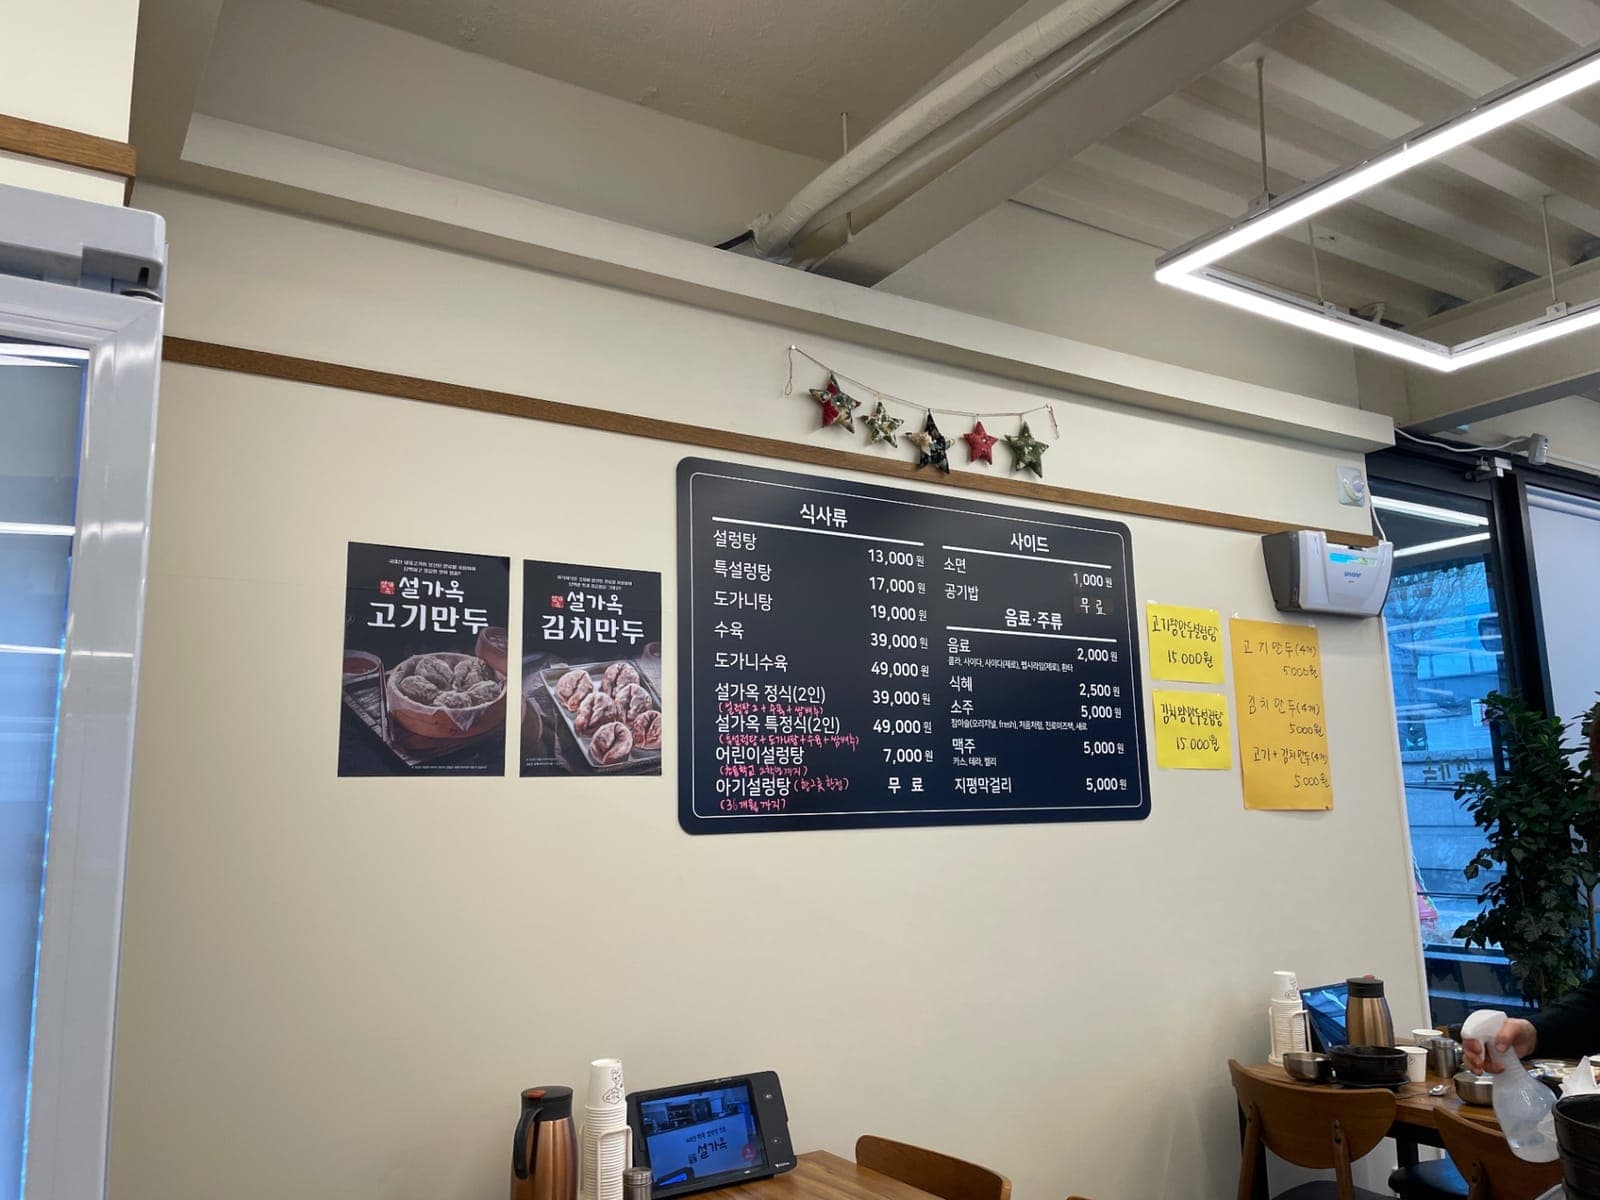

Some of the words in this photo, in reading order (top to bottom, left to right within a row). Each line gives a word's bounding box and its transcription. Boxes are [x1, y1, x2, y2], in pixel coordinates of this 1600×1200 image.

[799, 503, 848, 528] 식사류
[713, 529, 757, 551] 설렁탕
[1010, 532, 1050, 552] 사이드
[713, 559, 772, 582] 특설렁탕
[943, 557, 967, 574] 소면
[399, 577, 464, 603] 설가옥
[944, 583, 980, 602] 공기밥
[567, 591, 623, 615] 설가옥
[713, 591, 773, 611] 도가니탕
[367, 602, 489, 635] 고기만두
[1004, 608, 1063, 631] 음료·주류
[541, 615, 645, 645] 김치만두
[714, 621, 744, 640] 수육
[947, 637, 971, 654] 음료
[714, 652, 788, 673] 도가니수육
[715, 683, 760, 702] 설가옥
[764, 685, 826, 704] 정식(2인)
[949, 675, 973, 693] 식혜
[950, 699, 974, 716] 소주
[715, 714, 760, 733] 설가옥
[764, 715, 840, 735] 특정식(2인)
[715, 745, 804, 765] 어린이설렁탕
[952, 737, 976, 755] 맥주
[716, 777, 790, 797] 아기설렁탕
[954, 777, 1012, 794] 지평막걸리
